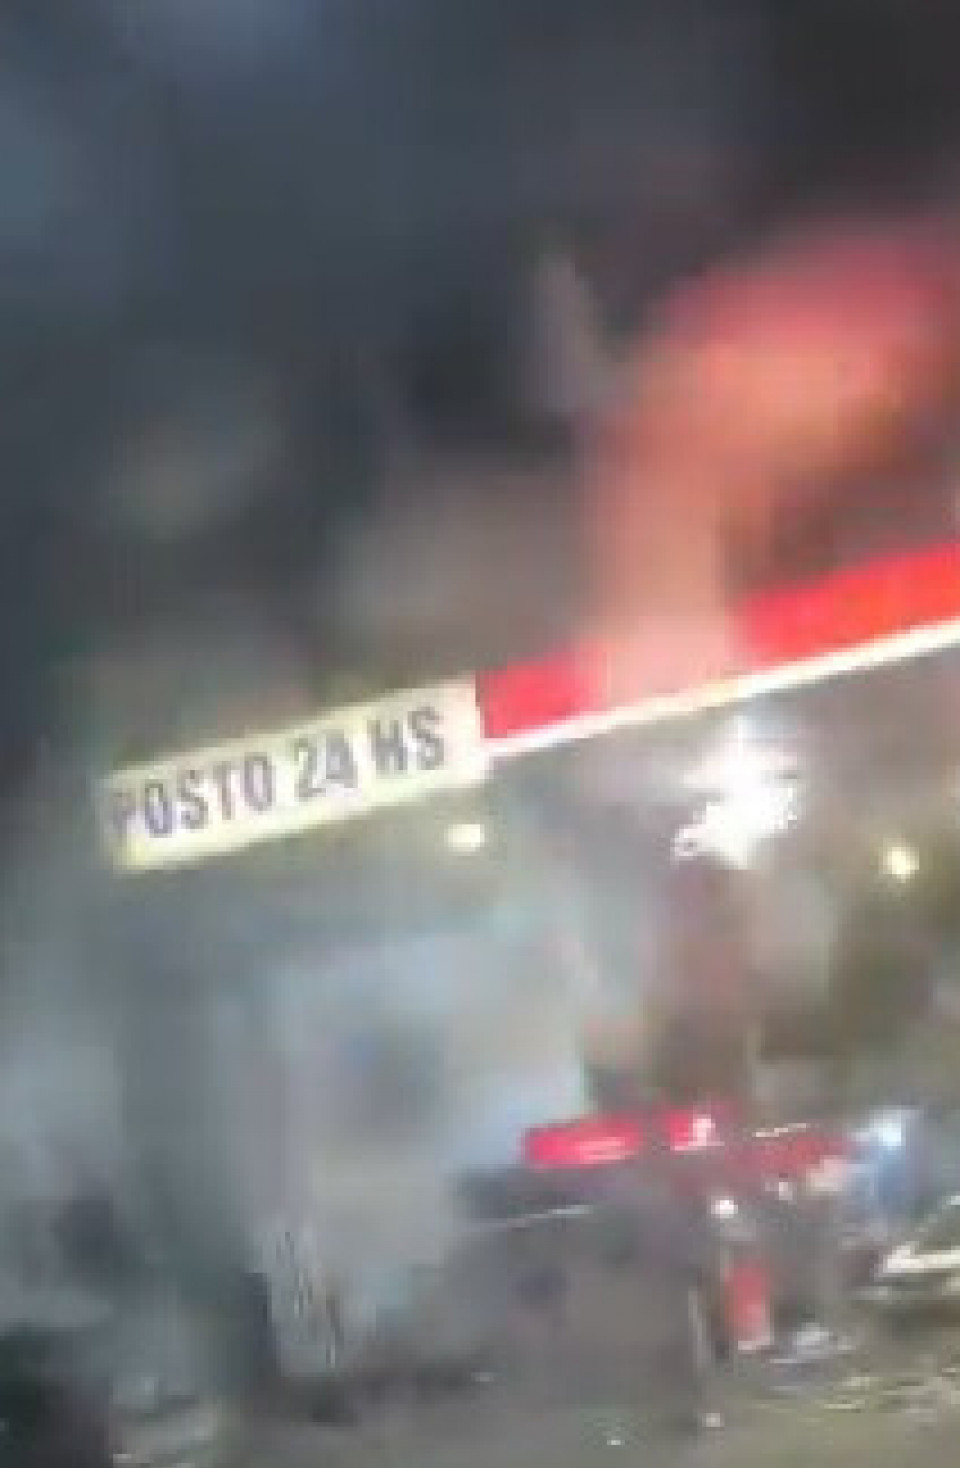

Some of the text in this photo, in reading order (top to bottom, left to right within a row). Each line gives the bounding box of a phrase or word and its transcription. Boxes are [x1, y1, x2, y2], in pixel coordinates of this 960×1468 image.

[112, 706, 445, 838] POSTO 24 HS
